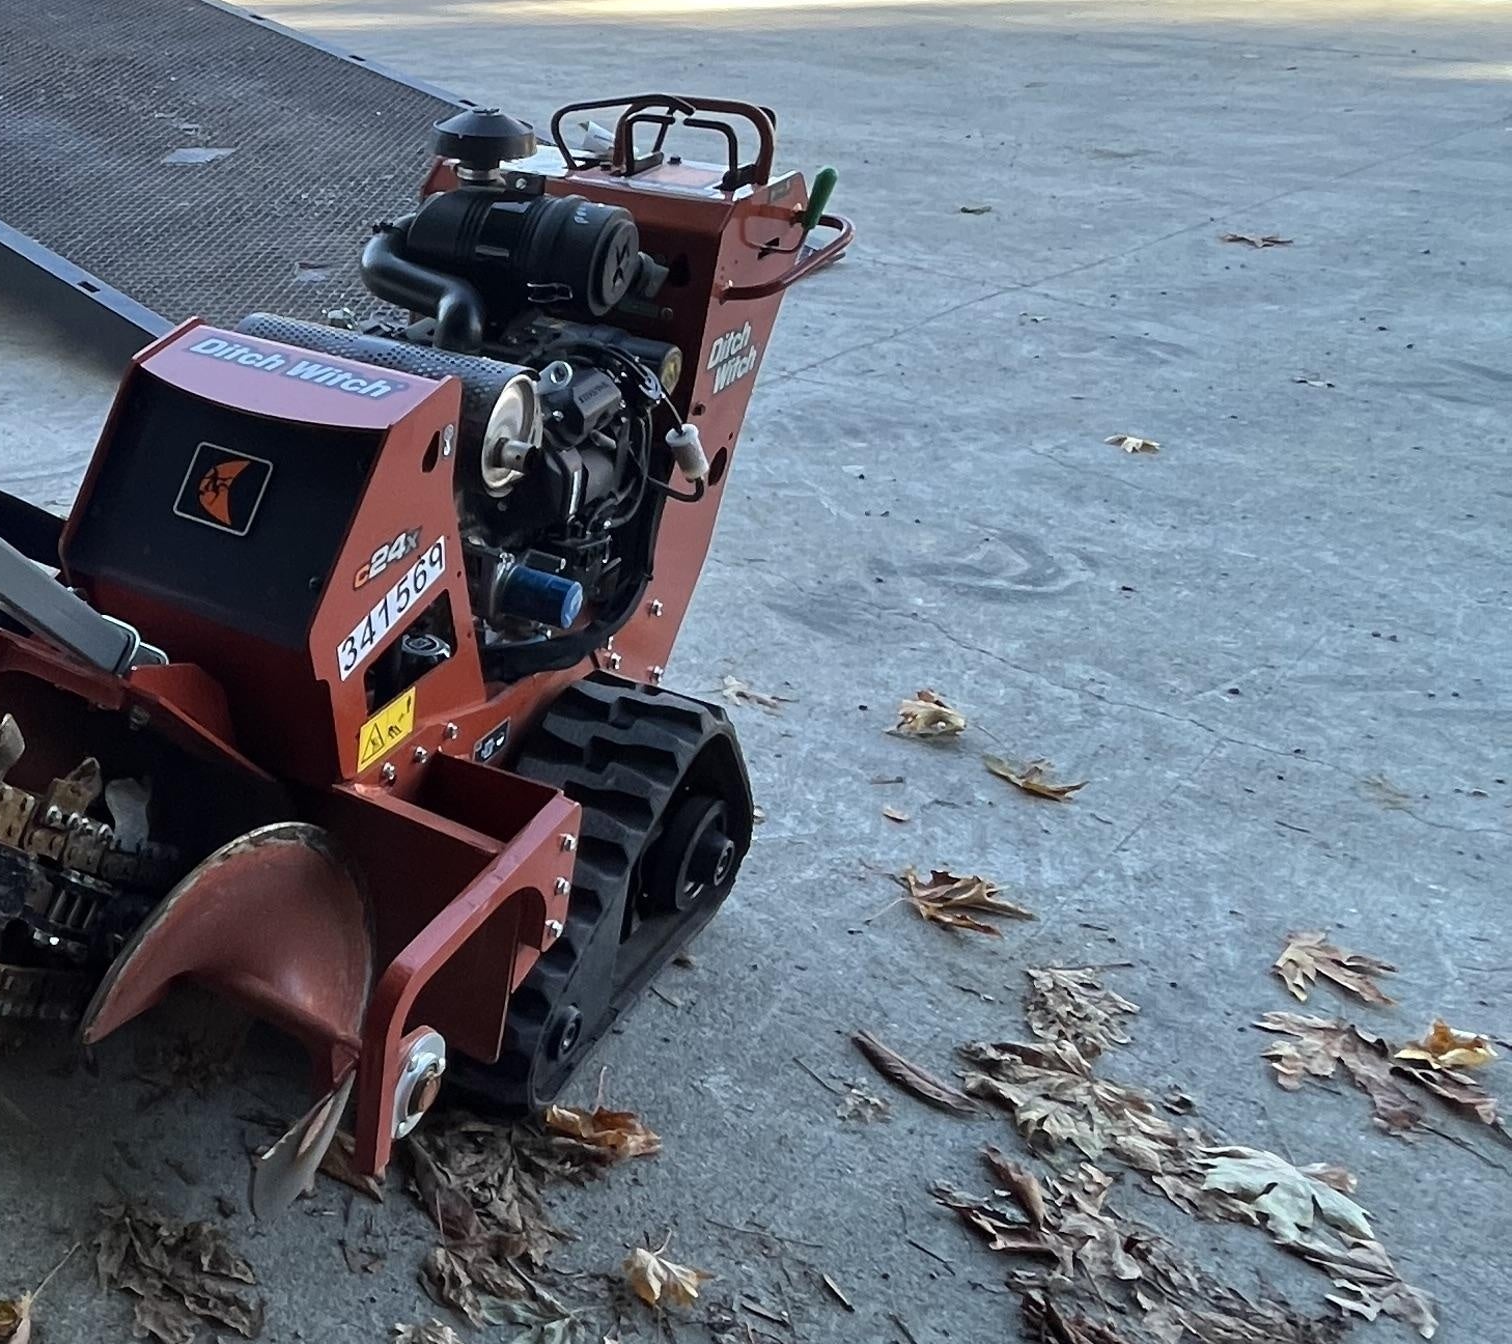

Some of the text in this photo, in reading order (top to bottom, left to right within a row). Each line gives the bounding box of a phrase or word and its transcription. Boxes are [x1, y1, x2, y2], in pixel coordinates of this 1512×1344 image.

[188, 337, 287, 372] Ditch
[706, 320, 752, 371] Ditch
[712, 345, 757, 394] Witch
[340, 542, 445, 672] 341569
